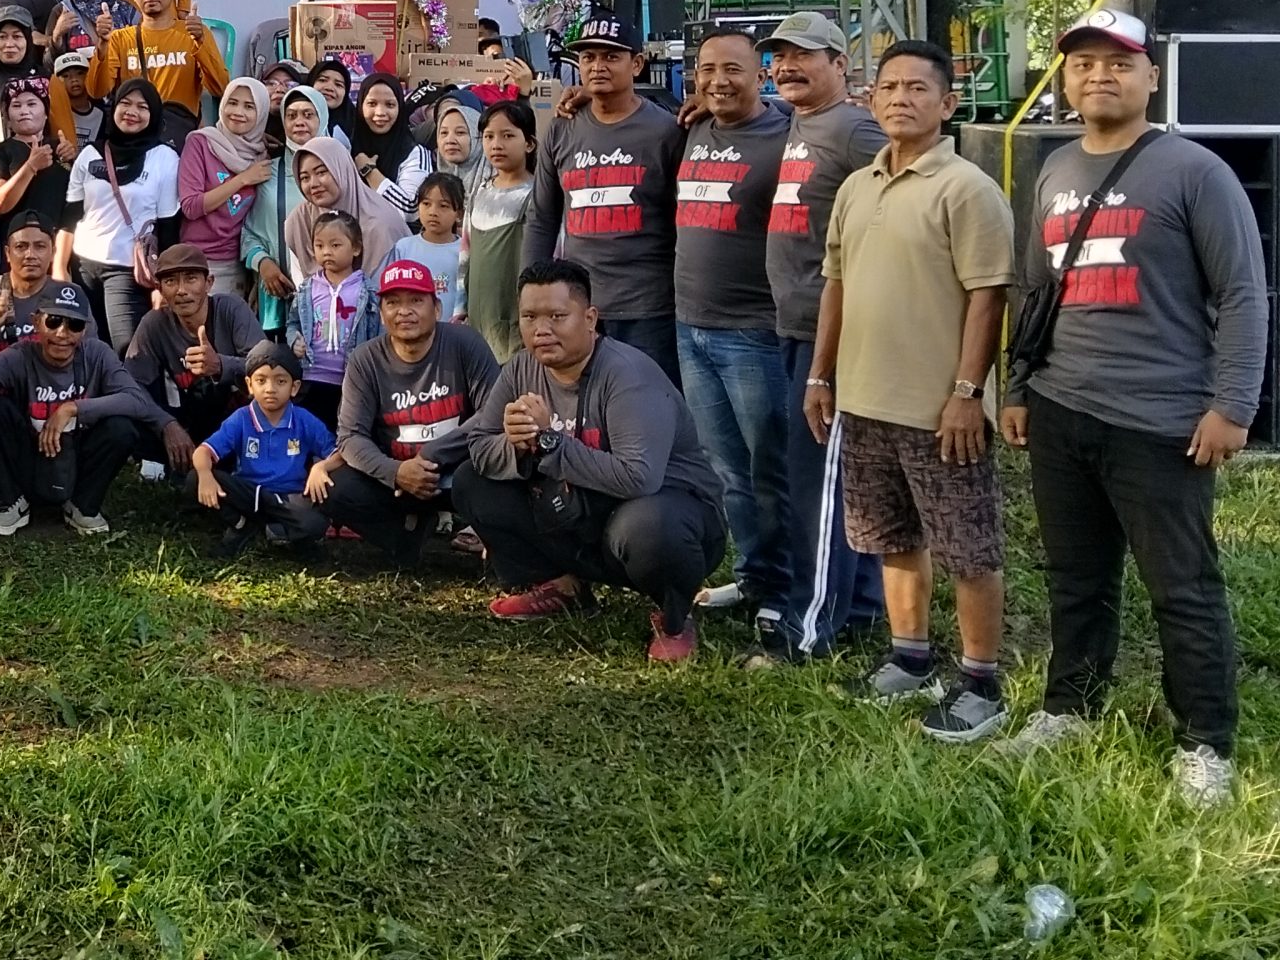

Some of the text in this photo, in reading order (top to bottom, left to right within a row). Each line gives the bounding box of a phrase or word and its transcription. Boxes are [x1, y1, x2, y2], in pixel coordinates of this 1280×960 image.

[575, 147, 633, 168] We Are
[690, 144, 741, 162] We Are
[591, 190, 608, 203] OF
[695, 185, 711, 198] OF
[1051, 189, 1081, 215] We
[36, 386, 57, 402] We
[391, 381, 450, 410] We Are
[421, 426, 438, 439] OF
